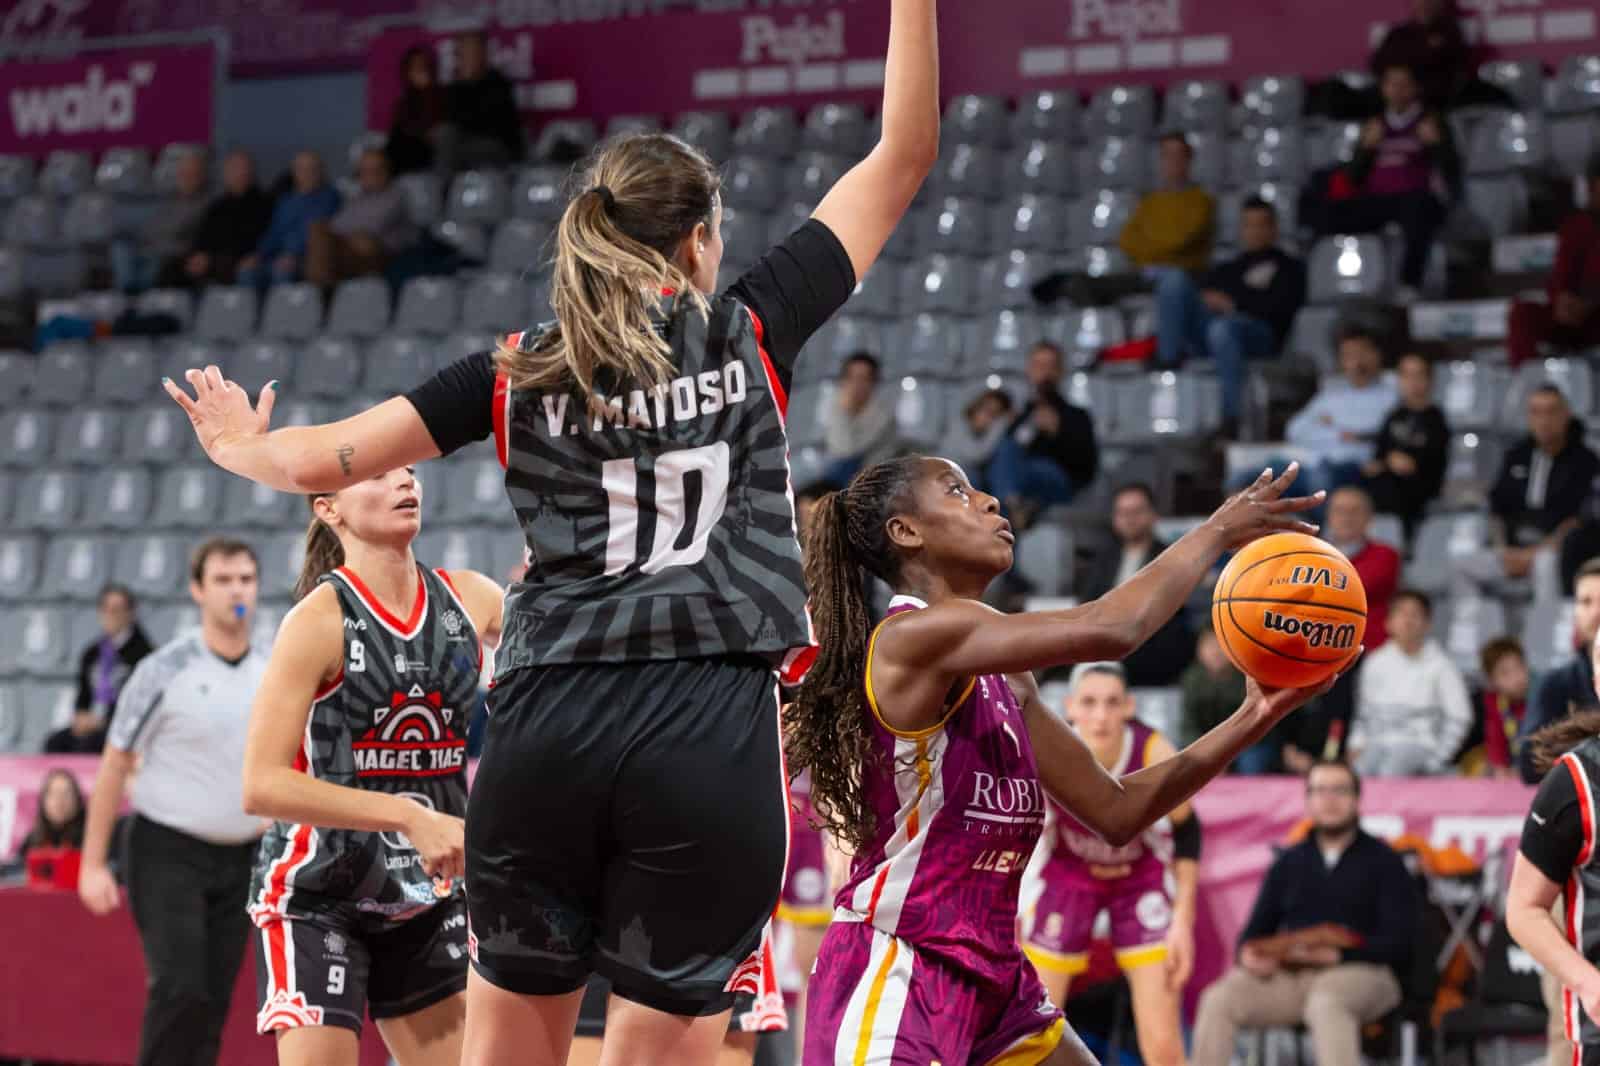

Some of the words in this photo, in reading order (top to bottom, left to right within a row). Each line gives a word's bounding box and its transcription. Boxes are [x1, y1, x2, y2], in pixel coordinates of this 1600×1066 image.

[541, 394, 578, 438] V.
[590, 359, 747, 432] MATOSO
[602, 440, 730, 577] 10
[1290, 566, 1347, 591] EVO
[1263, 610, 1356, 649] Wilson
[349, 639, 366, 672] 9
[353, 748, 422, 771] MAGEC
[967, 771, 1046, 813] ROBI
[327, 965, 346, 995] 9
